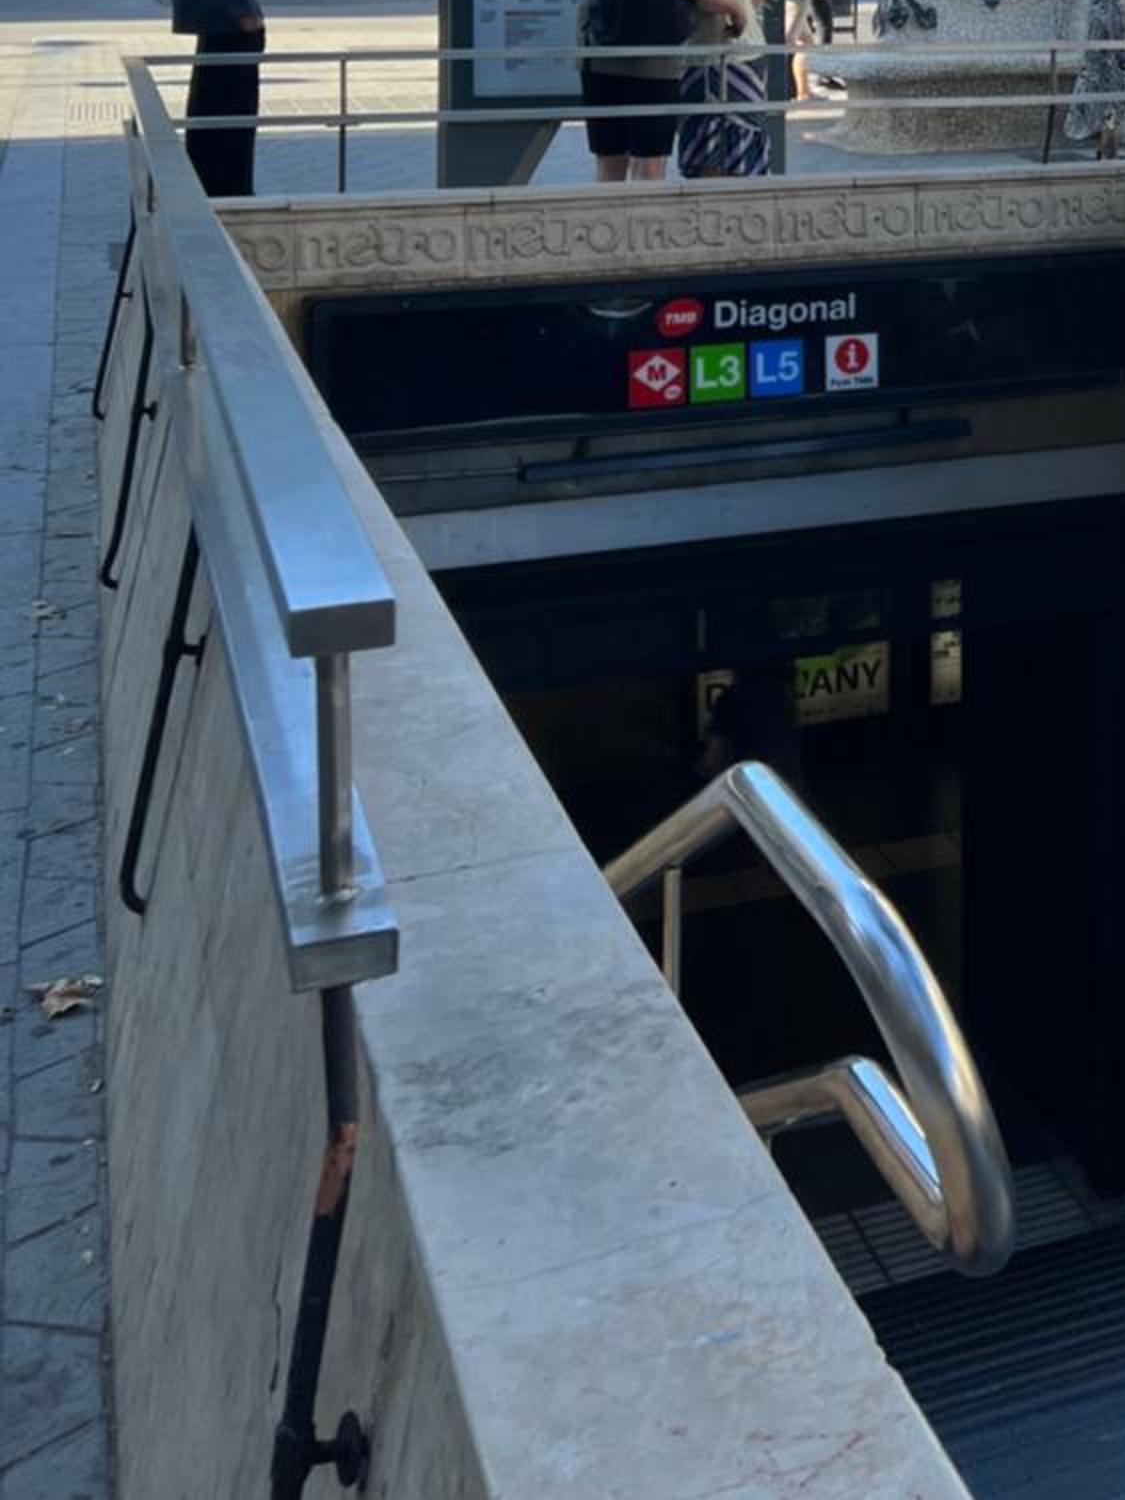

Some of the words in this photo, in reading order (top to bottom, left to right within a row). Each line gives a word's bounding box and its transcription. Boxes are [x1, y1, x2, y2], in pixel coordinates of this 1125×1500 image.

[714, 292, 857, 332] Diagonal
[695, 355, 741, 389] L3
[756, 350, 801, 384] L5
